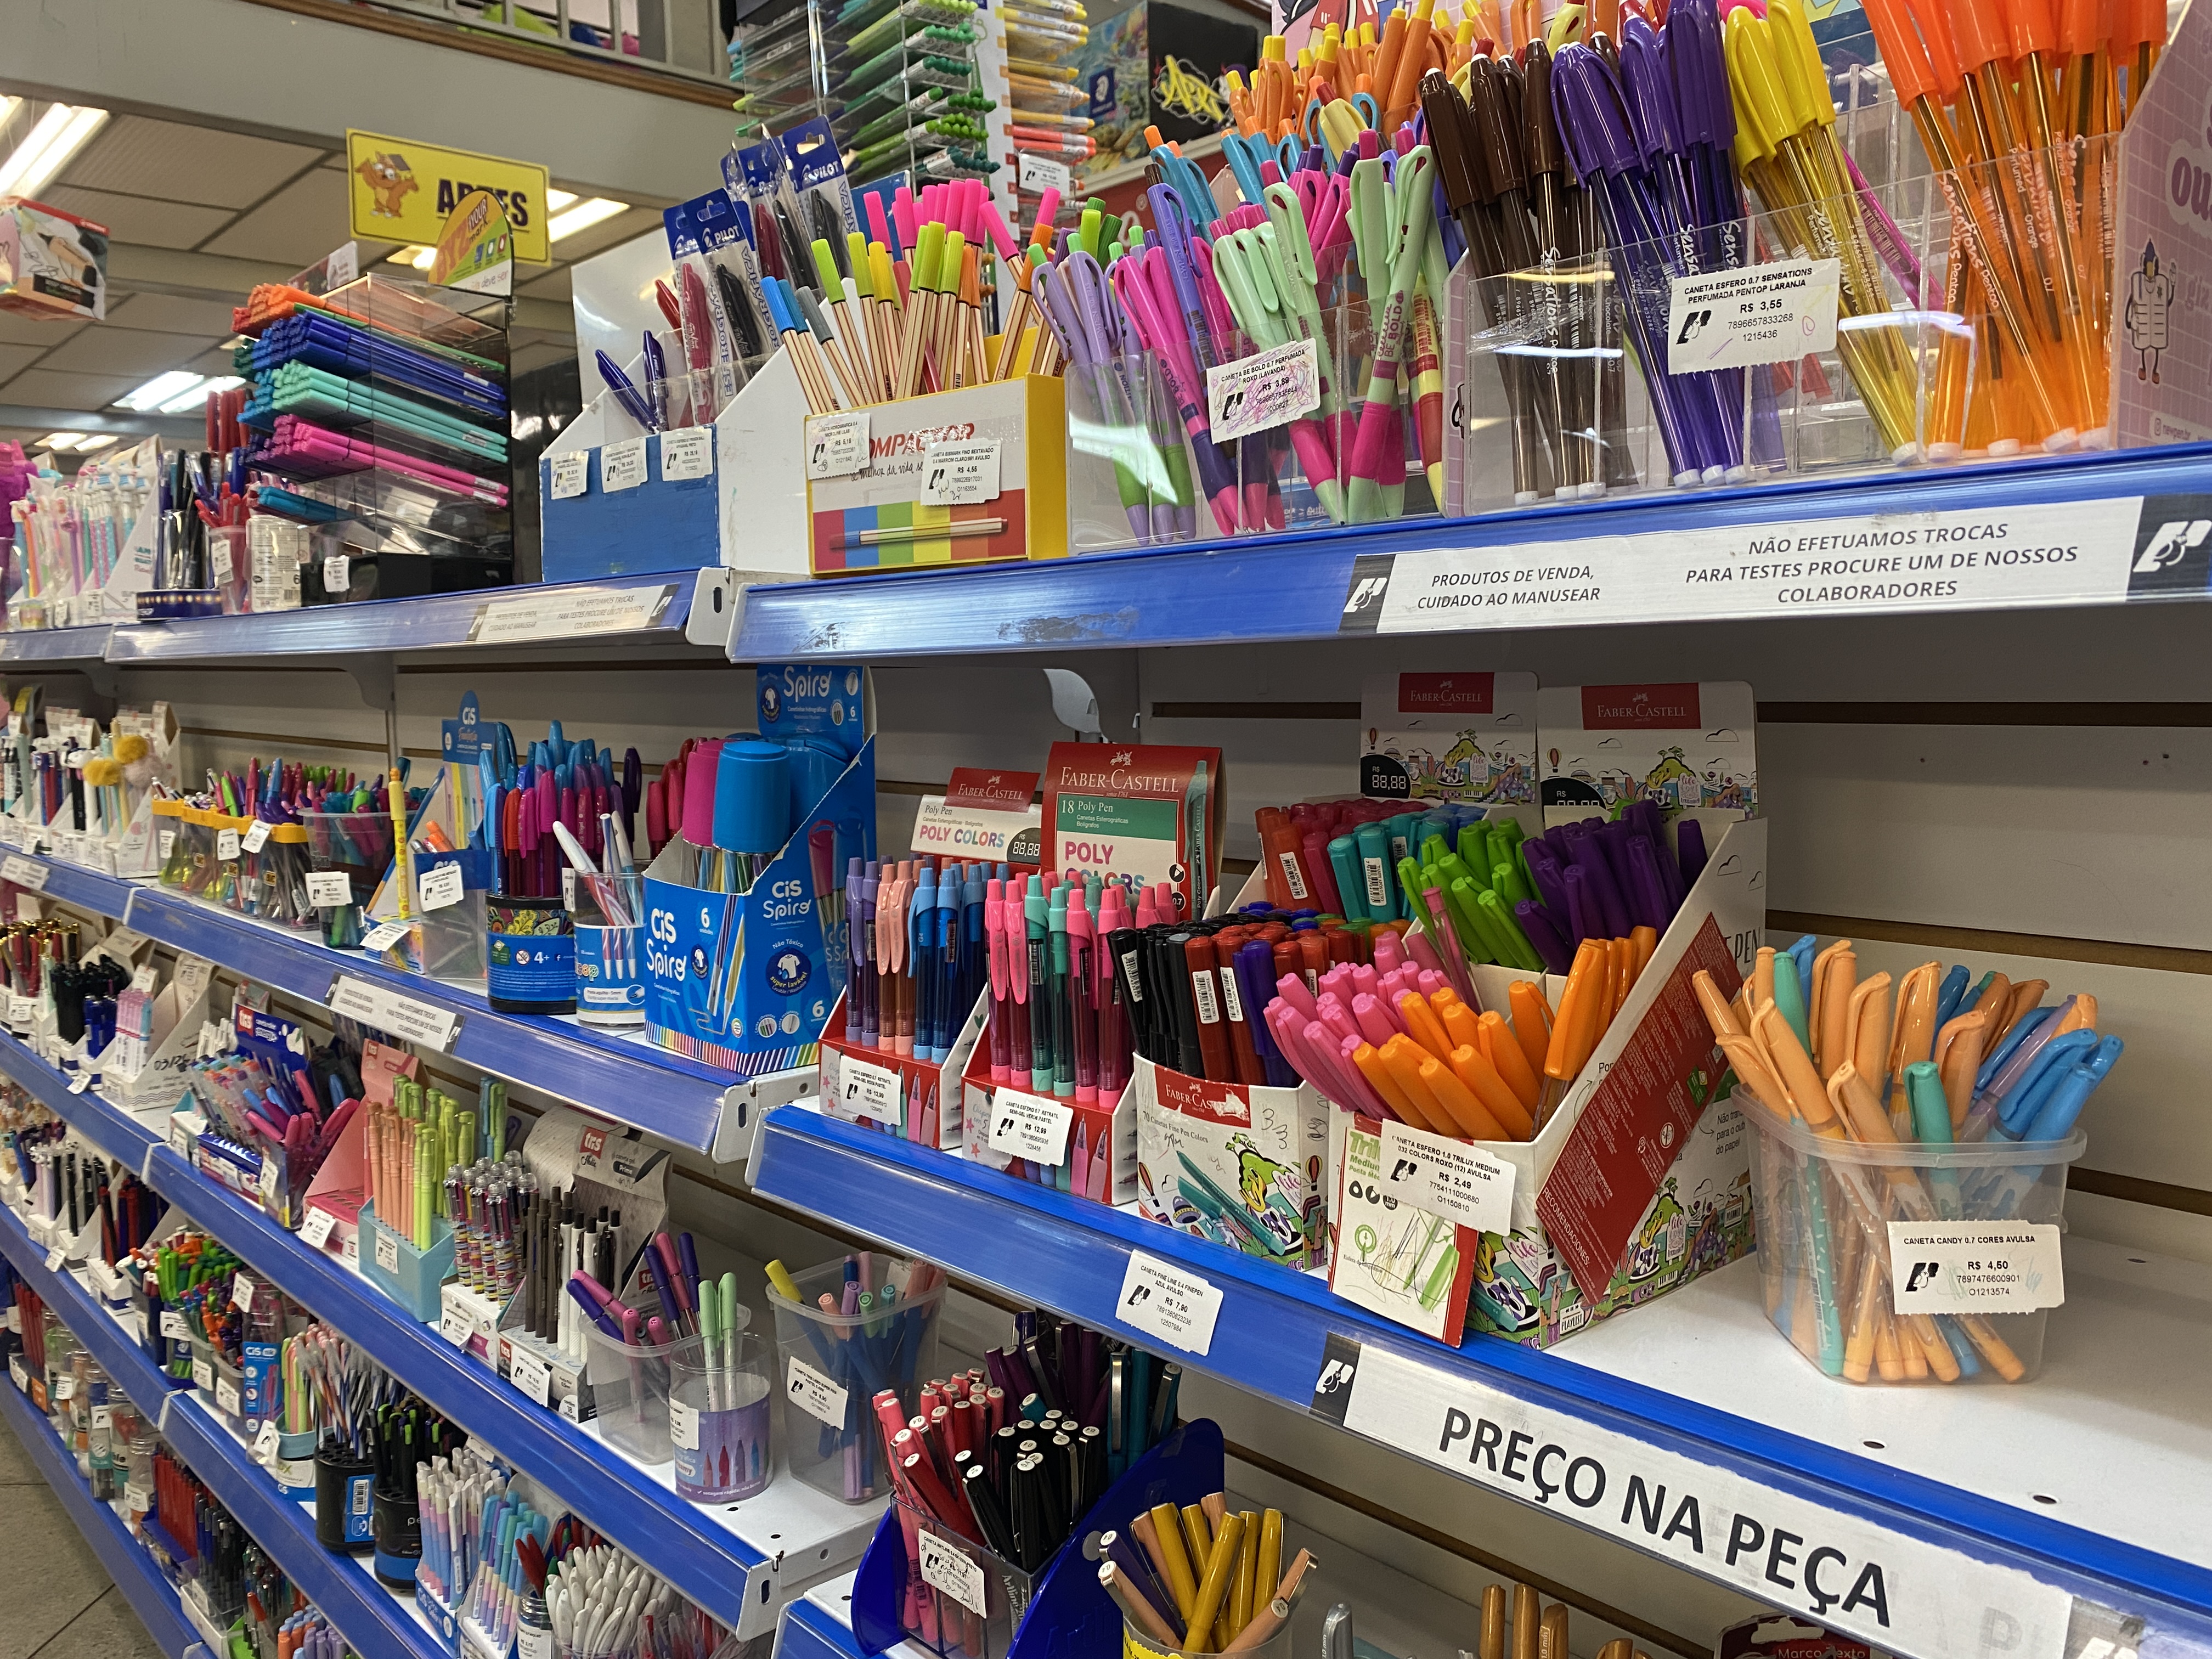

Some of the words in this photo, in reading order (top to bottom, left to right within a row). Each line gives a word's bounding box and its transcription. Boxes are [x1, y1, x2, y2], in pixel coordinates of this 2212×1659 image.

[714, 225, 740, 244] PILOT
[1685, 284, 1713, 295] CANETA
[1716, 279, 1746, 290] ESFERO
[1762, 268, 1812, 282] SENSATIONS
[1688, 290, 1734, 304] PERFUMADA
[1736, 285, 1768, 297] PENTOP
[1769, 279, 1805, 291] LARANJA
[1740, 303, 1753, 313] R$
[1760, 299, 1782, 312] 3,55
[1388, 306, 1402, 340] BOLD
[1728, 313, 1793, 330] 7896657833268
[1743, 330, 1778, 341] 1215436
[1385, 341, 1393, 358] BE
[1221, 372, 1242, 382] CANETA
[1251, 364, 1265, 373] BOLD
[1275, 349, 1305, 365] PERFUMADA
[1243, 374, 1257, 384] ROXO
[1259, 365, 1285, 380] (LAVANDA)
[1262, 383, 1272, 392] R$
[1748, 537, 1791, 555] NÃO
[1797, 531, 1917, 552] EFETUAMOS
[1924, 523, 2008, 543] TROCAS
[1686, 567, 1733, 583] PARA
[1740, 563, 1802, 580] TESTES
[1808, 557, 1902, 576] PROCURE
[1908, 555, 1943, 570] UM
[1950, 552, 1978, 568] DE
[1984, 546, 2078, 566] NOSSOS
[1432, 571, 1509, 587] PRODUTOS
[1513, 569, 1534, 583] DE
[1538, 566, 1594, 580] VENDA,
[1418, 594, 1483, 609] CUIDADO
[1486, 593, 1508, 606] AO
[1512, 588, 1600, 605] MANUSEAR
[1778, 580, 1957, 603] COLABORADORES
[1410, 690, 1482, 702] FABER-CASTELL
[1597, 704, 1686, 718] FABER-CASTELL
[1060, 767, 1178, 793] FABER-CASTELL
[1372, 774, 1407, 790] 88,88
[957, 783, 1023, 800] FABER-CASTELL
[925, 805, 940, 817] Poly
[940, 805, 953, 816] Pen
[1062, 799, 1074, 814] 18
[1078, 800, 1096, 814] Poly
[1097, 802, 1113, 813] Pen
[1077, 814, 1096, 823] Canetas
[919, 825, 950, 842] POLY
[953, 829, 1005, 848] COLORS
[1065, 840, 1114, 865] POLY
[772, 879, 802, 898] CiS
[651, 908, 676, 944] CiS
[701, 907, 710, 928] 6
[772, 939, 785, 949] Não
[786, 939, 804, 949] Tóxico
[534, 951, 549, 963] 4+
[770, 975, 786, 988] super
[812, 1000, 825, 1018] 6
[1006, 1101, 1019, 1110] CANETA
[1041, 1109, 1059, 1119] RETRATIL
[1143, 1111, 1150, 1122] 70
[1169, 1123, 1180, 1134] Fine
[1180, 1127, 1190, 1138] Pen
[1190, 1132, 1208, 1143] Colors
[1717, 1113, 1729, 1125] Não
[1717, 1127, 1729, 1138] para
[1716, 1144, 1723, 1154] do
[1724, 1140, 1741, 1153] papel
[1409, 1149, 1434, 1162] COLORS
[1436, 1158, 1453, 1168] ROXO
[1454, 1164, 1465, 1173] (12)
[1467, 1167, 1491, 1181] AVULSA
[1417, 1143, 1441, 1155] ESFERO
[1442, 1151, 1451, 1159] 1.0
[1453, 1154, 1474, 1167] TRILUX
[1475, 1161, 1500, 1176] MEDIUM
[618, 1163, 633, 1176] Prime
[1349, 1165, 1367, 1177] Ponta
[1439, 1172, 1449, 1182] R$
[1454, 1178, 1471, 1189] 2,49
[1430, 1181, 1480, 1204] 7754111000680
[1967, 1261, 1981, 1270] R$
[1987, 1261, 2008, 1271] 4,50
[1141, 1265, 1157, 1277] CANETA
[1158, 1272, 1167, 1282] FINE
[1167, 1277, 1178, 1286] LINE
[1184, 1284, 1204, 1297] FINEPEN
[1957, 1275, 2021, 1283] 7897476600901
[1155, 1279, 1166, 1289] AZUL
[1166, 1285, 1184, 1297] AVULSO
[1165, 1297, 1173, 1306] R$
[1176, 1302, 1188, 1313] 7,90
[1561, 1313, 1583, 1330] PLAYLIST
[1440, 1407, 1606, 1508] PREÇO
[1621, 1475, 1703, 1554] NA
[1725, 1513, 1890, 1628] PEÇA
[1778, 1647, 1821, 1659] Marco
